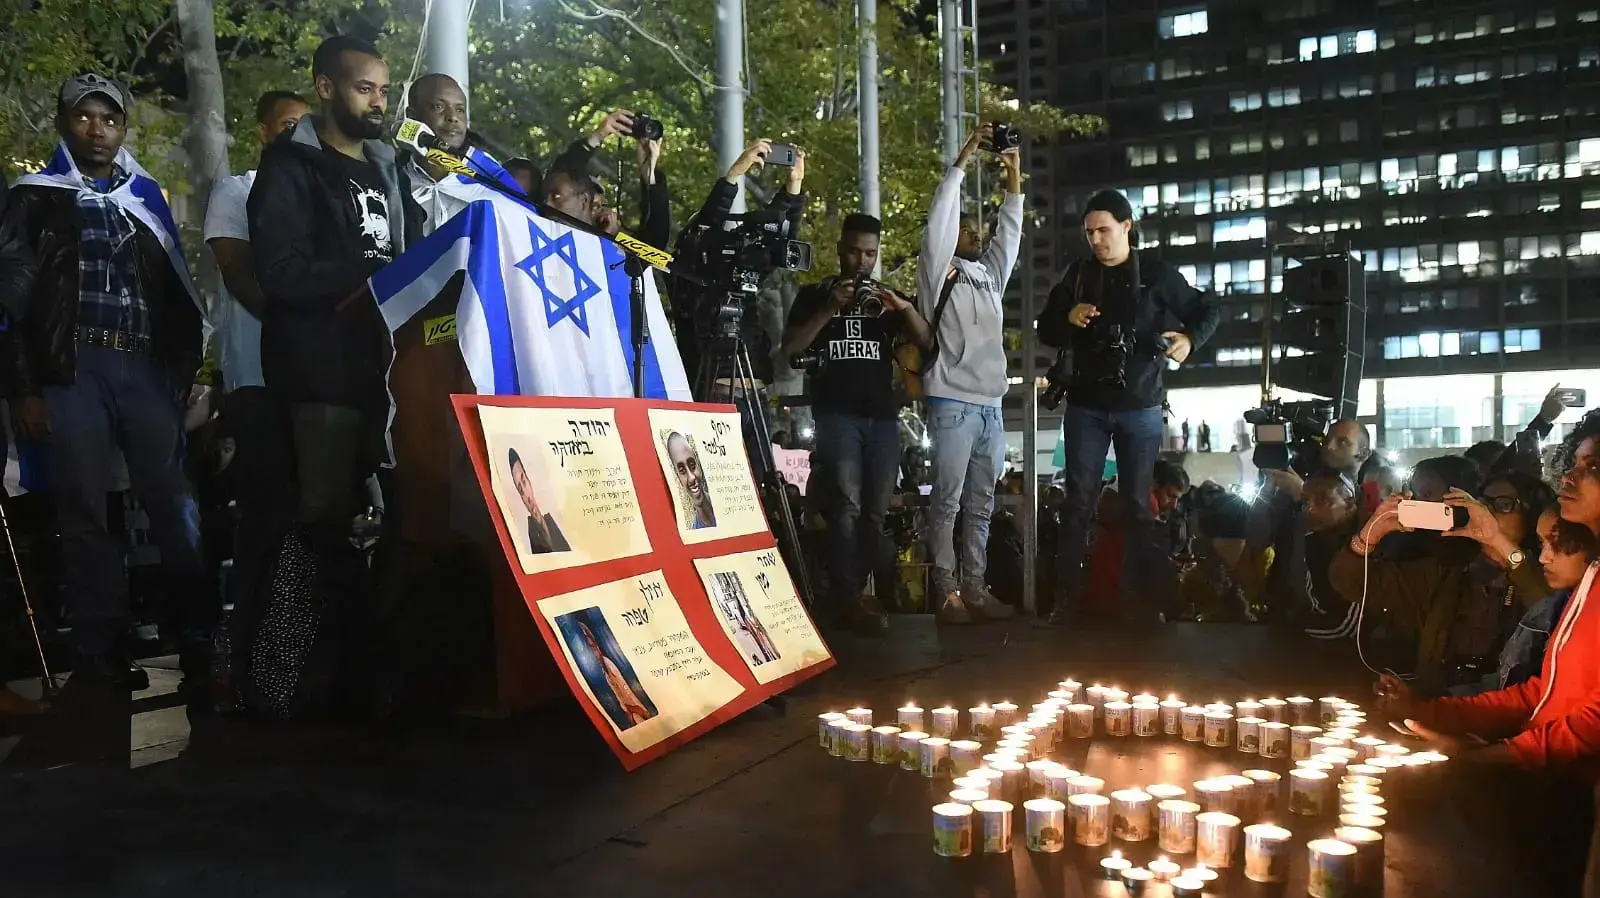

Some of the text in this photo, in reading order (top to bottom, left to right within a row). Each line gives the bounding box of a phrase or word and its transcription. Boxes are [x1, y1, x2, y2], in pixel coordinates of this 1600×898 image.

[847, 320, 860, 337] IS
[831, 341, 879, 359] AVERA?
[567, 419, 611, 438] יהודה
[710, 419, 731, 442] יוסף
